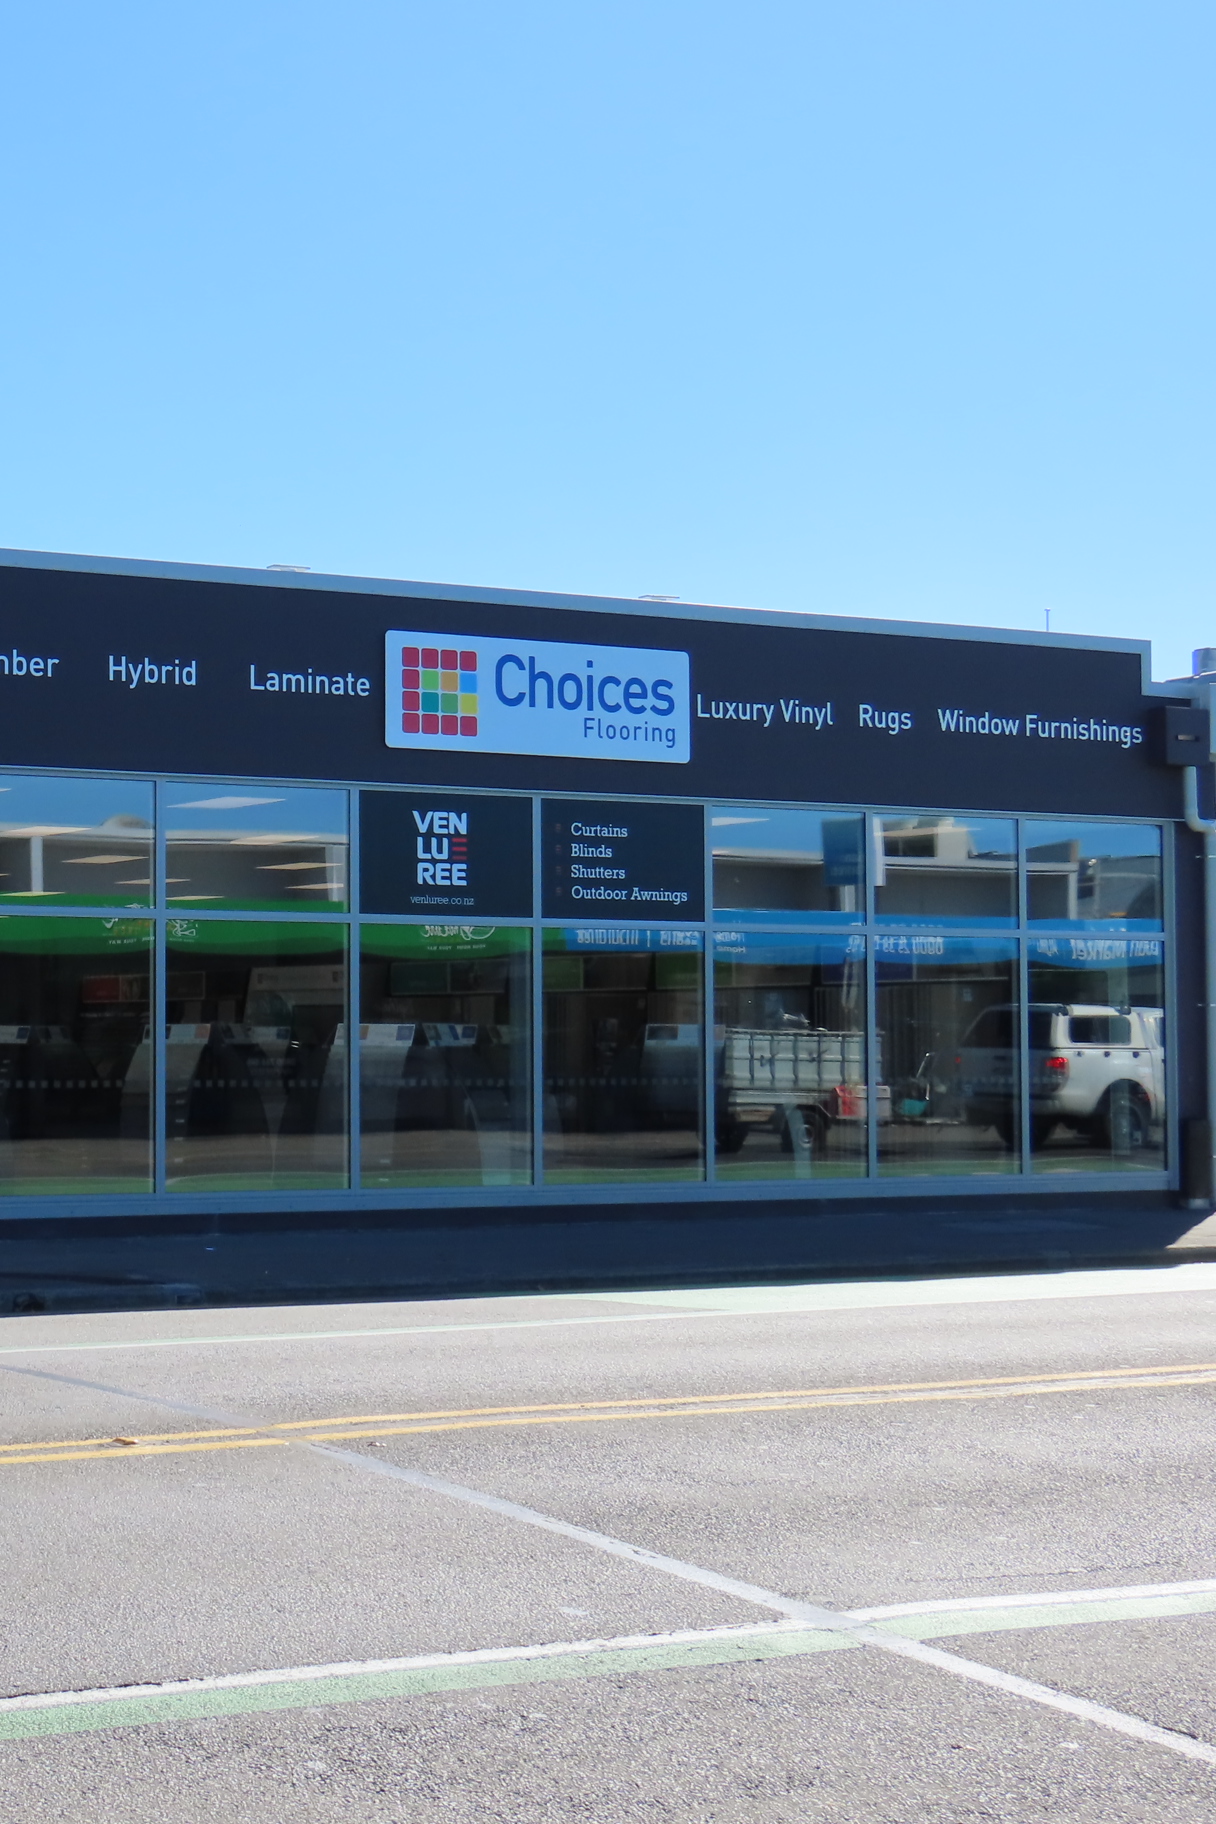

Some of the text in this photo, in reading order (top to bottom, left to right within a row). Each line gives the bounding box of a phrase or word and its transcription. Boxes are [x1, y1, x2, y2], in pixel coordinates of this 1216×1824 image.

[108, 655, 196, 689] Hybrid
[249, 664, 370, 697] Laminate
[495, 653, 676, 716] Choices
[696, 693, 834, 731] Luxury Vinyl
[859, 704, 912, 736] Rugs
[583, 717, 676, 749] Flooring
[937, 708, 1143, 749] Window Furnishings
[412, 810, 467, 835] VEN
[570, 822, 629, 838] Curtains
[570, 843, 613, 858] Blinds
[416, 862, 467, 886] REE
[570, 864, 626, 880] Shutters
[410, 894, 474, 906] venluree.co.nz
[570, 885, 688, 905] Outdoor Awnings
